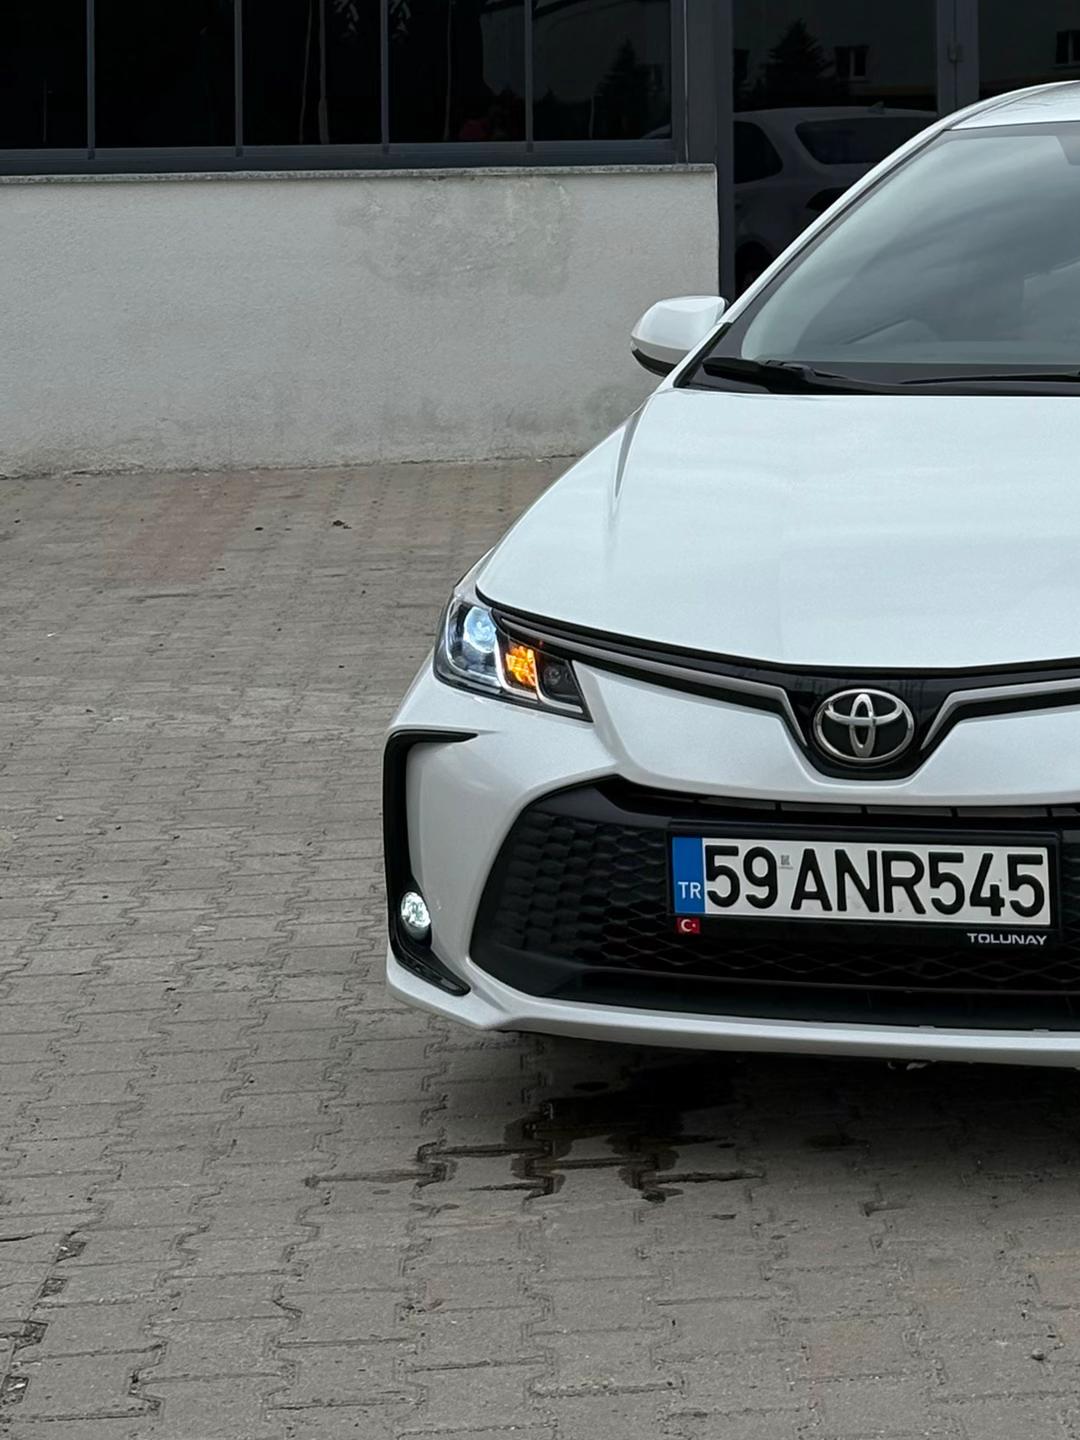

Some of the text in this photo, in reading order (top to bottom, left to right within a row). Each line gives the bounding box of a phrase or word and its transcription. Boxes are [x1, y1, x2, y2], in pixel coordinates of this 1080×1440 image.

[704, 844, 779, 908] 59
[677, 880, 702, 900] TR
[966, 932, 1048, 946] TOLUNAY
